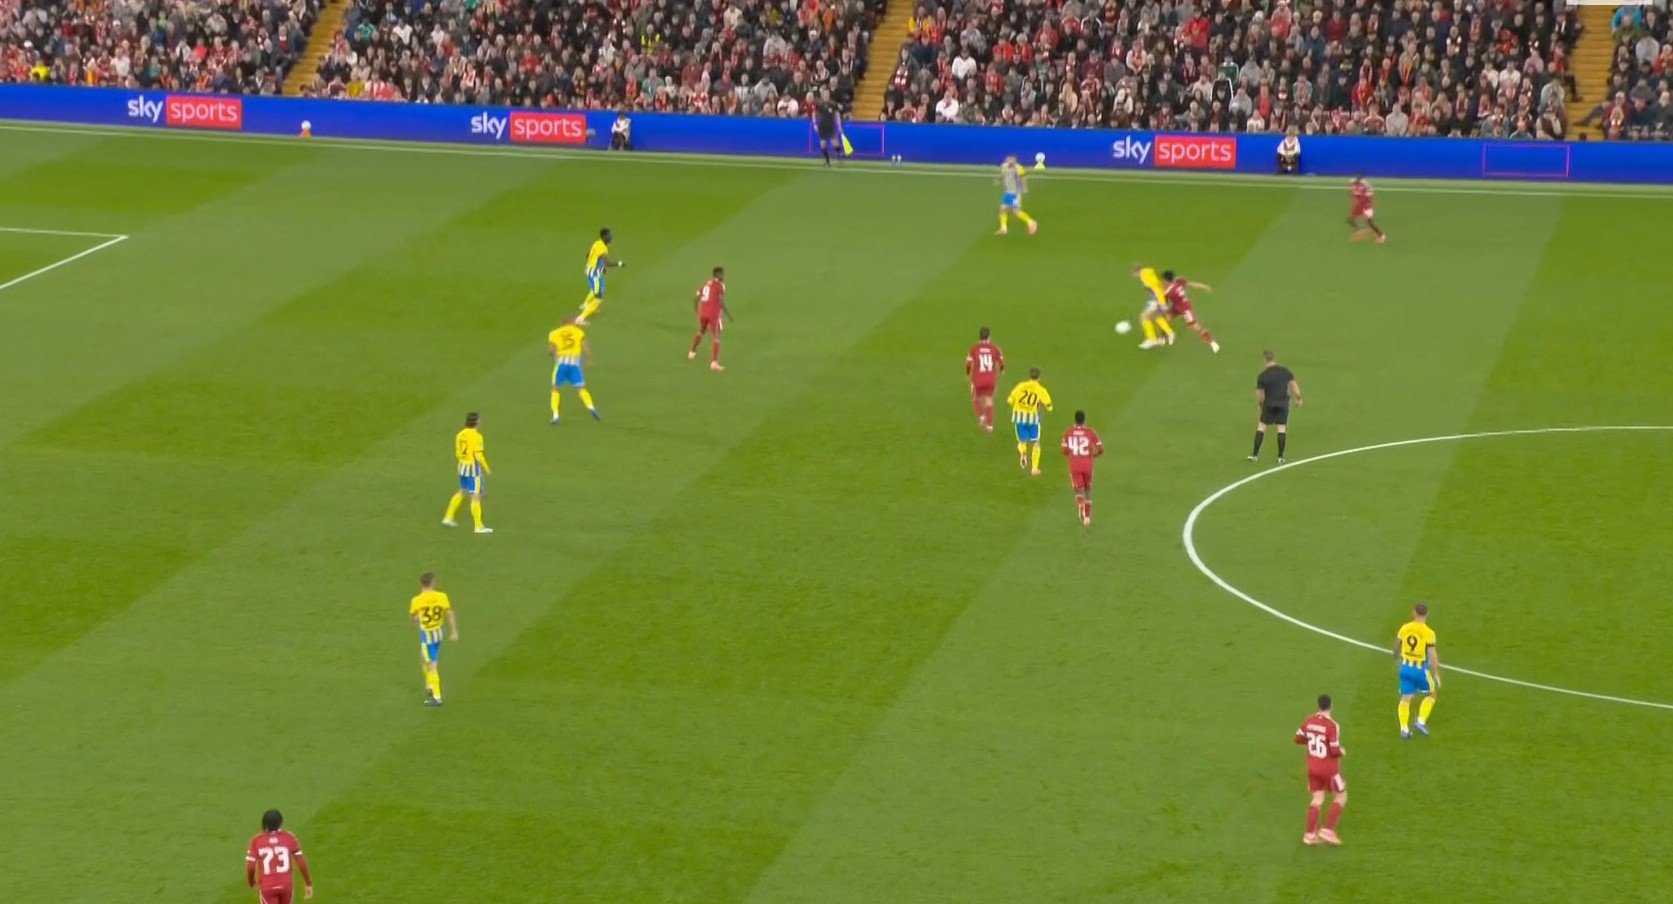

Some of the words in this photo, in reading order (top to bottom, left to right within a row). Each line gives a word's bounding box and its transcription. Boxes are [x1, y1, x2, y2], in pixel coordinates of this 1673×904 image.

[127, 94, 164, 123] sky
[169, 101, 238, 123] sports
[471, 110, 507, 140] sky
[514, 117, 582, 139] sports
[1112, 134, 1151, 165] sky
[1158, 141, 1232, 164] sports
[978, 353, 994, 373] 14
[1018, 390, 1038, 407] 20
[1067, 436, 1090, 456] 42
[420, 605, 442, 625] 38
[1406, 634, 1418, 651] 9
[1306, 731, 1328, 759] 26
[258, 846, 290, 876] 73
